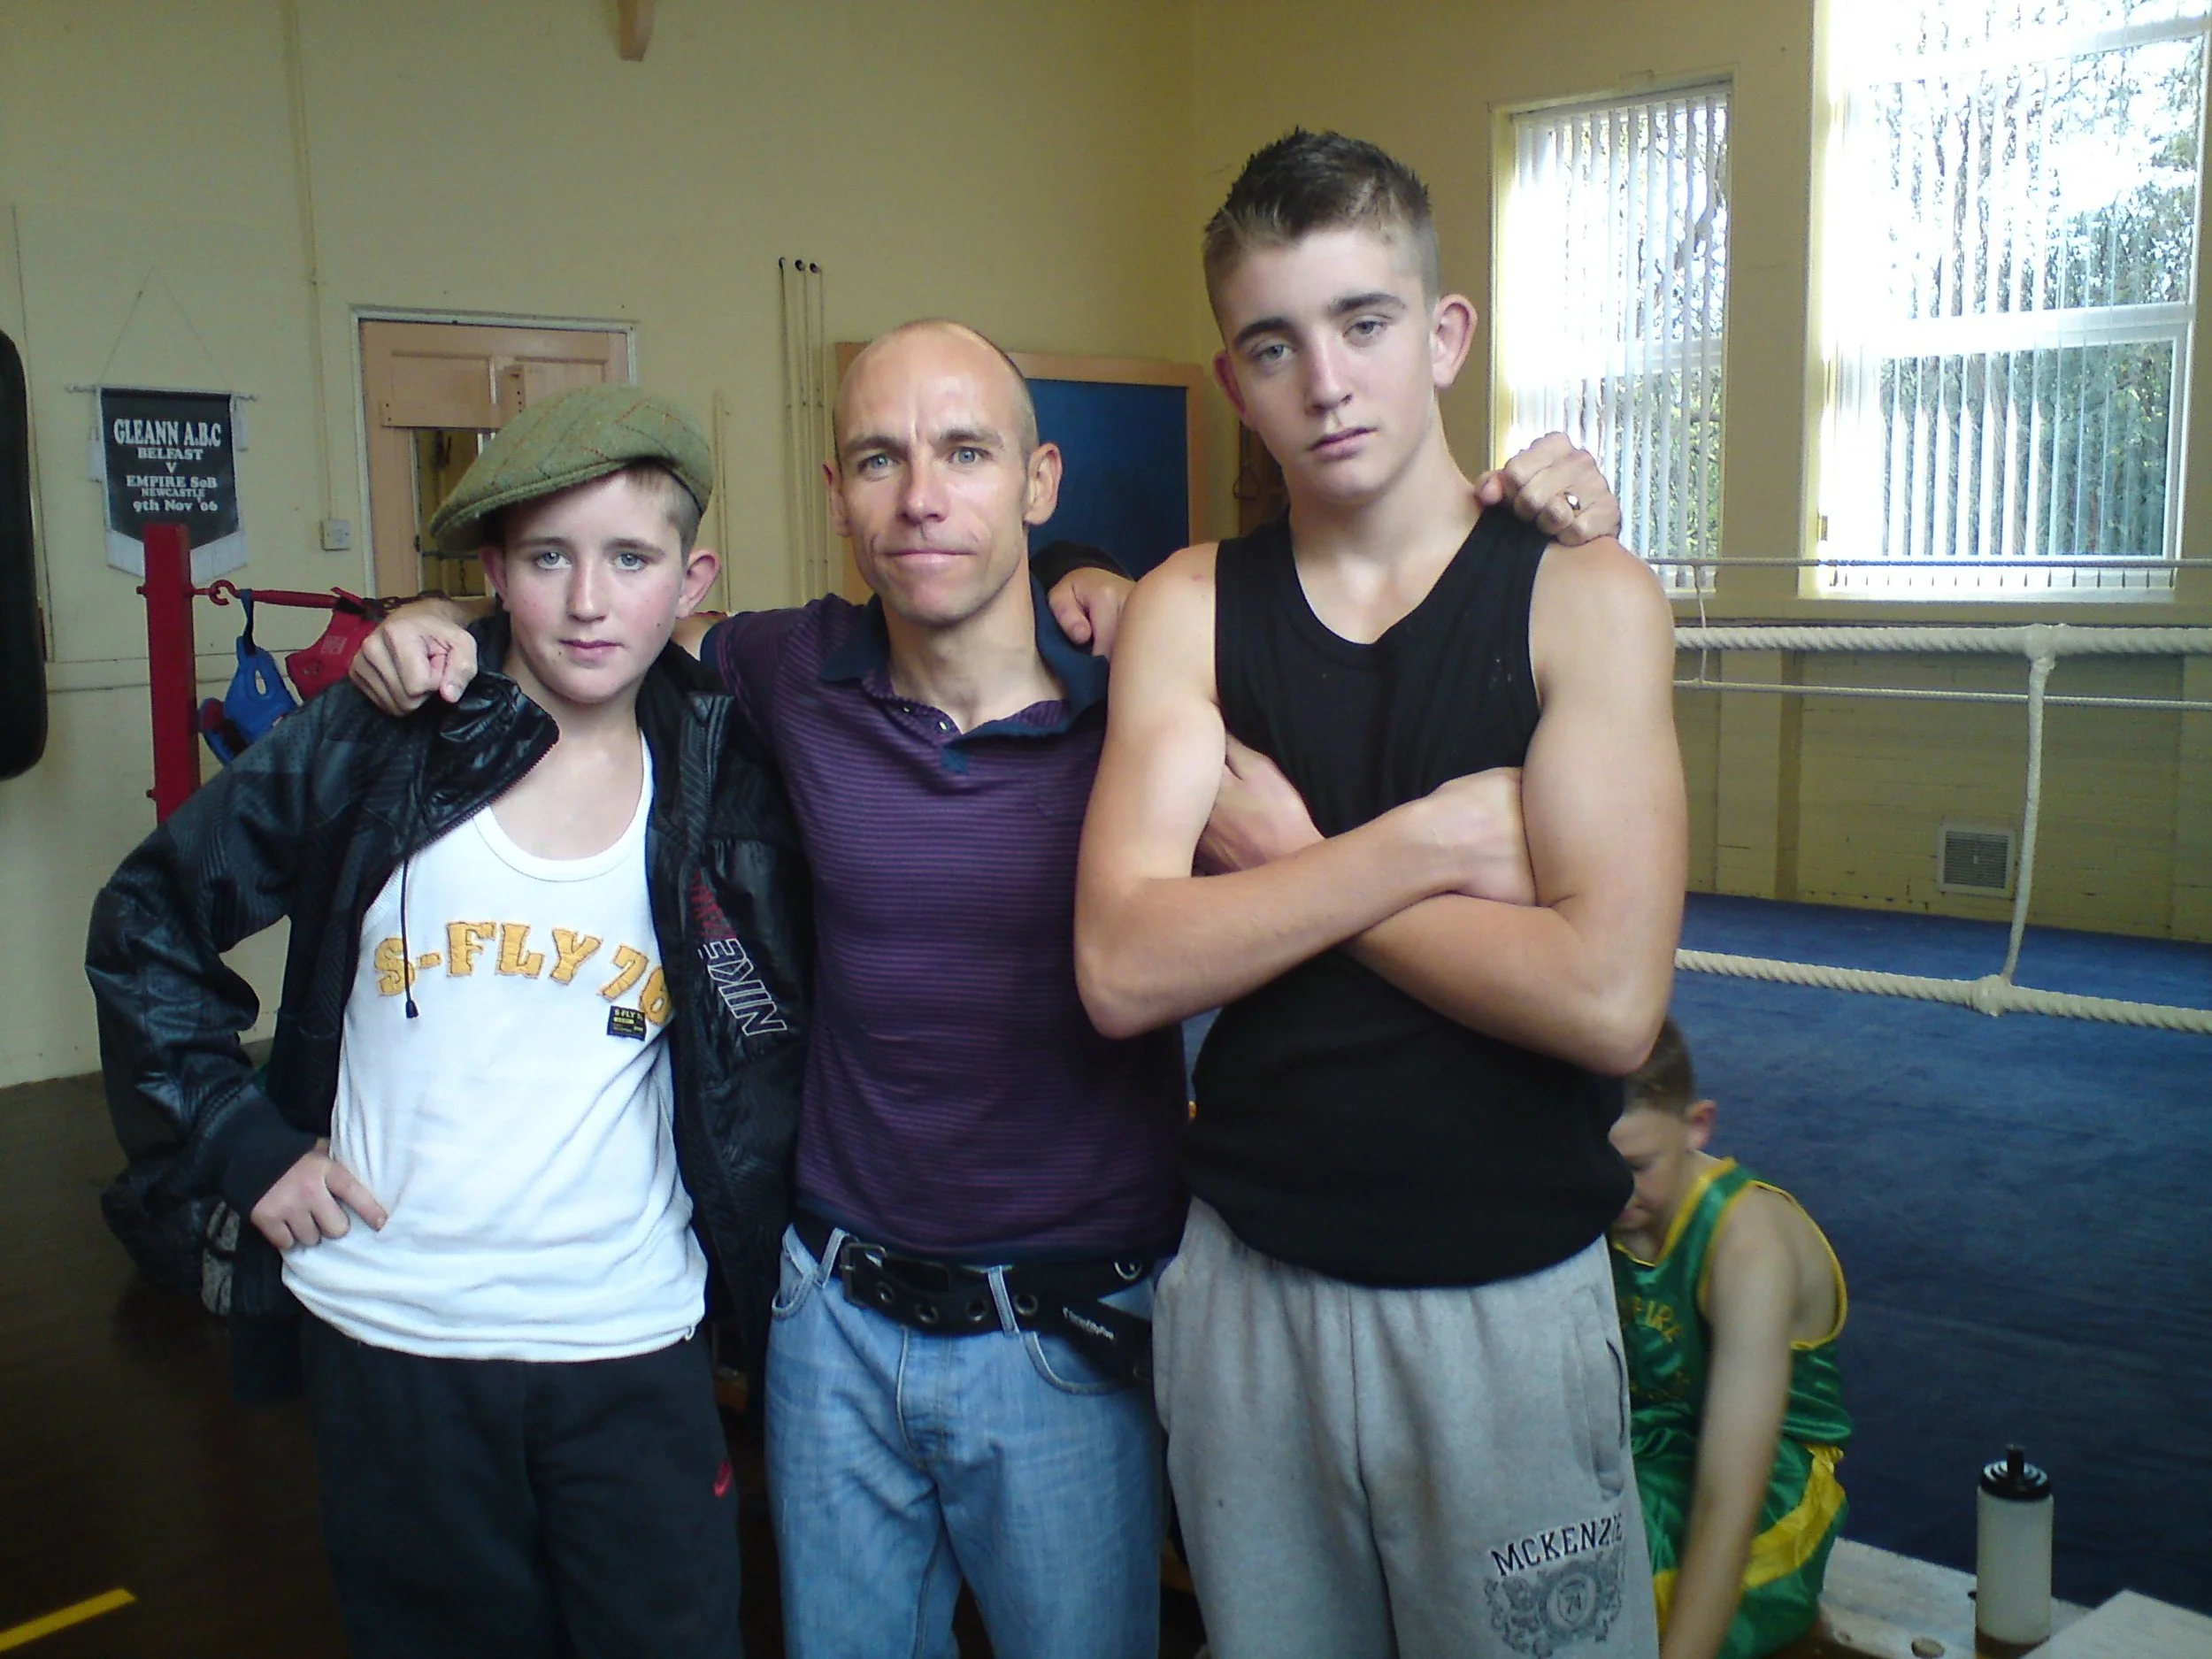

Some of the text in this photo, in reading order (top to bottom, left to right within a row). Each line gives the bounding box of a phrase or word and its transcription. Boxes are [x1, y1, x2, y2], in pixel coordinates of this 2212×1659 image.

[113, 419, 178, 446] GLEANN
[137, 447, 204, 460] BELFAST
[127, 475, 186, 488] EMPIRE
[142, 488, 205, 497] NEWCASTLE
[133, 500, 159, 512] 9th
[165, 500, 193, 511] Nov
[698, 939, 787, 1036] NIKE
